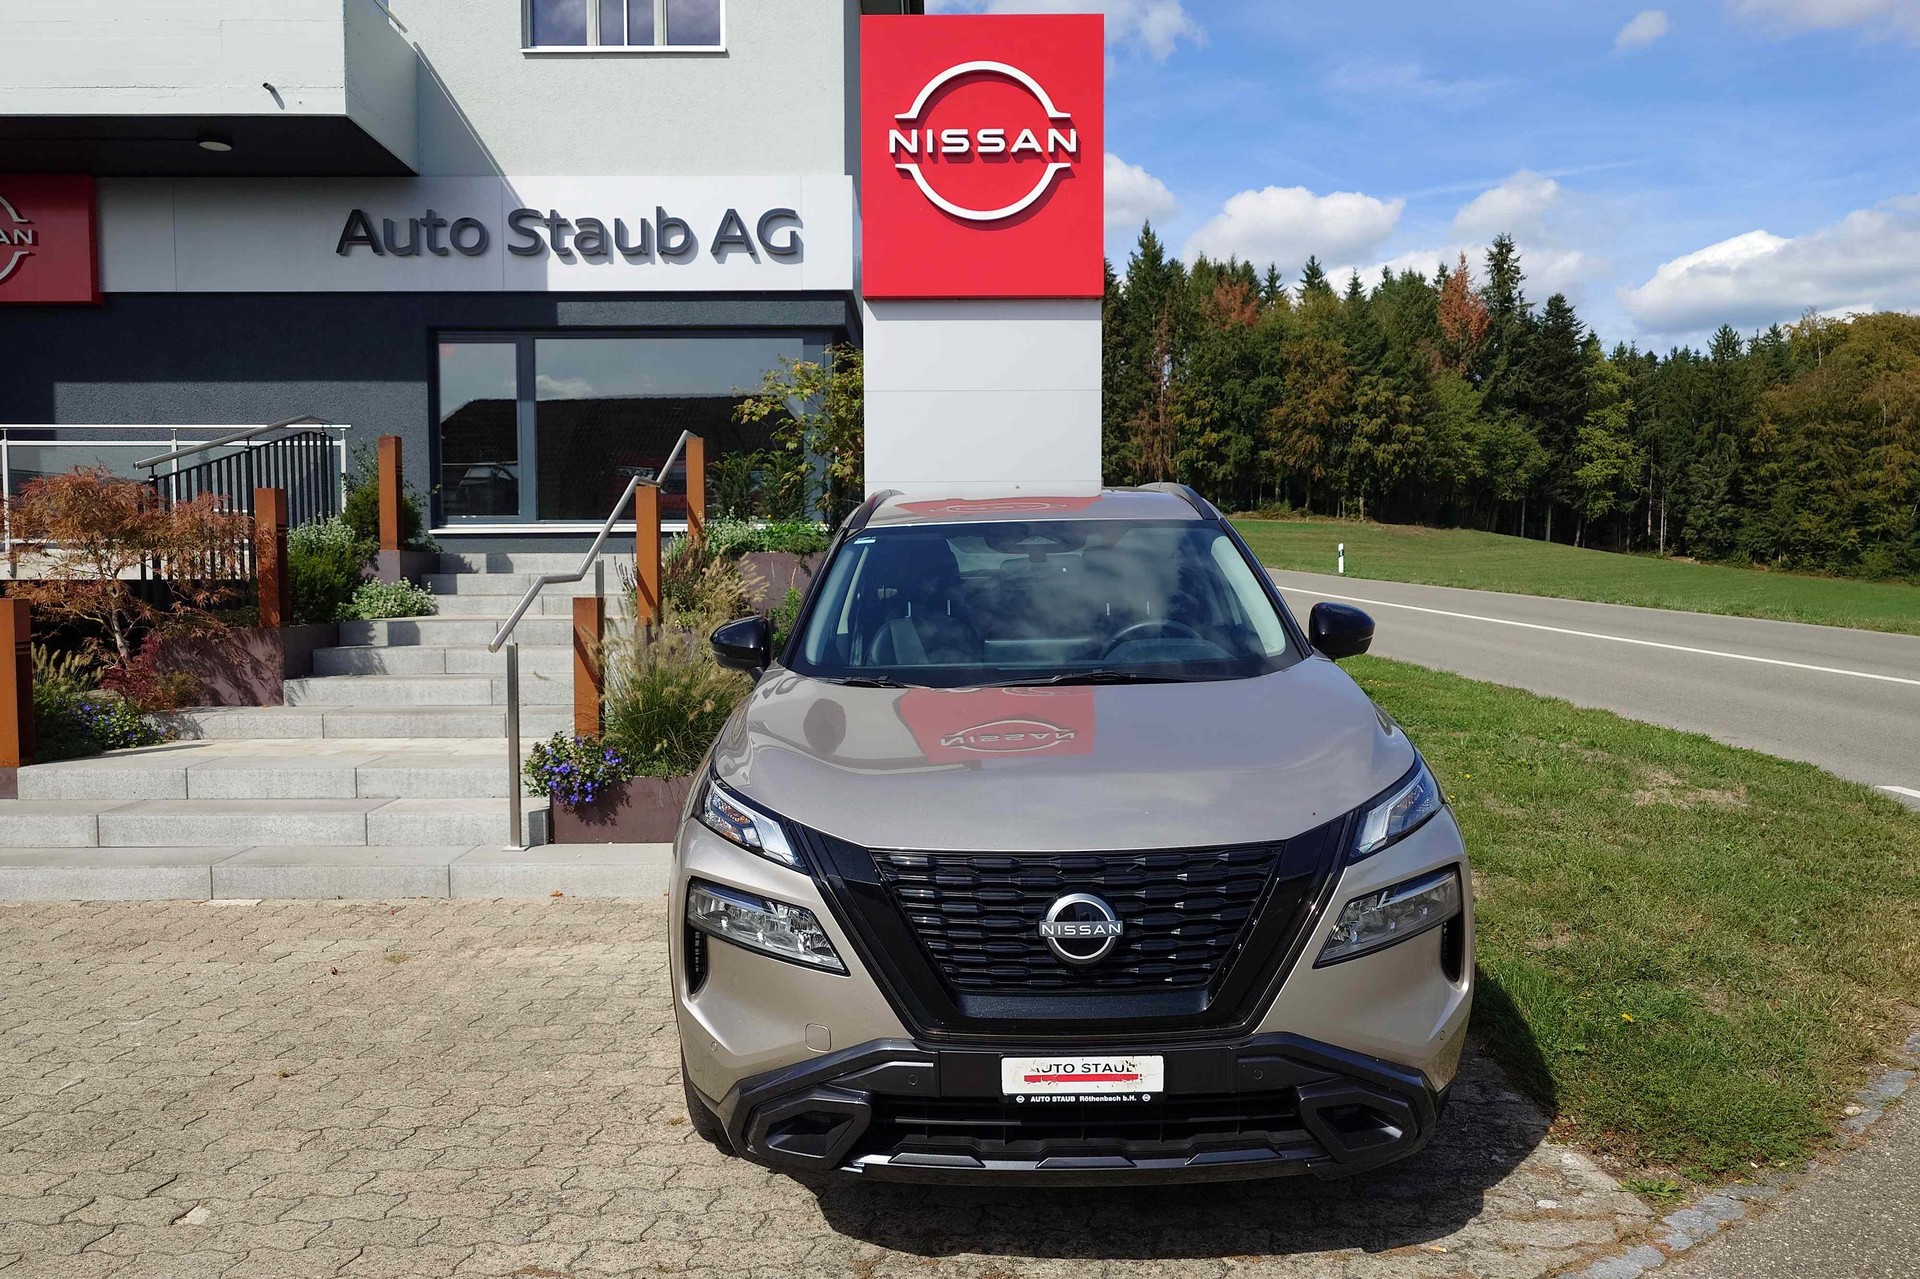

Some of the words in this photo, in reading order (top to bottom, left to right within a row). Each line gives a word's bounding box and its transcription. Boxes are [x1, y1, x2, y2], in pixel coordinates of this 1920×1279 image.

[888, 128, 1077, 154] NISSAN
[335, 208, 490, 256] Auto
[507, 206, 692, 256] Staub
[710, 207, 799, 256] AG
[1041, 923, 1121, 935] NISSAN
